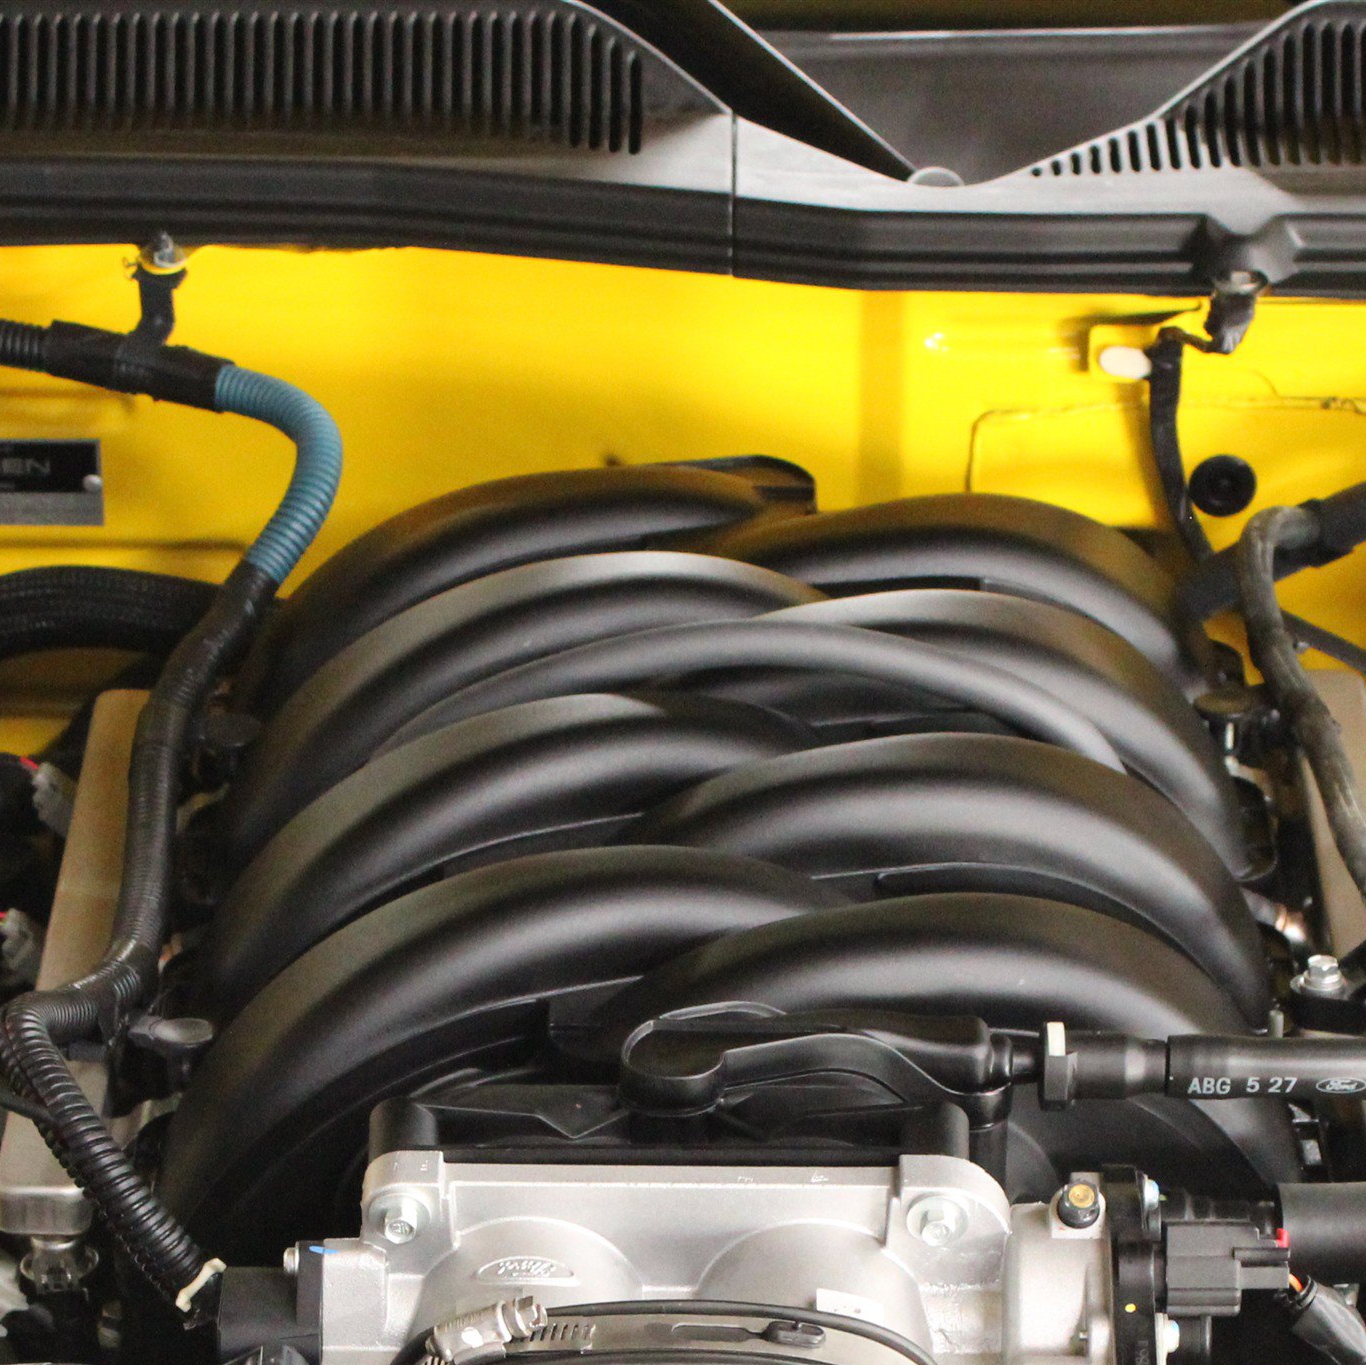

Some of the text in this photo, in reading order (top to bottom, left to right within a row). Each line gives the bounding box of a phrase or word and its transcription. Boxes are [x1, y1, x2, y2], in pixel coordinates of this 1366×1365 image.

[1187, 1076, 1232, 1095] ABG
[1246, 1076, 1261, 1093] 5
[1267, 1076, 1298, 1093] 27
[1320, 1076, 1364, 1093] Ford
